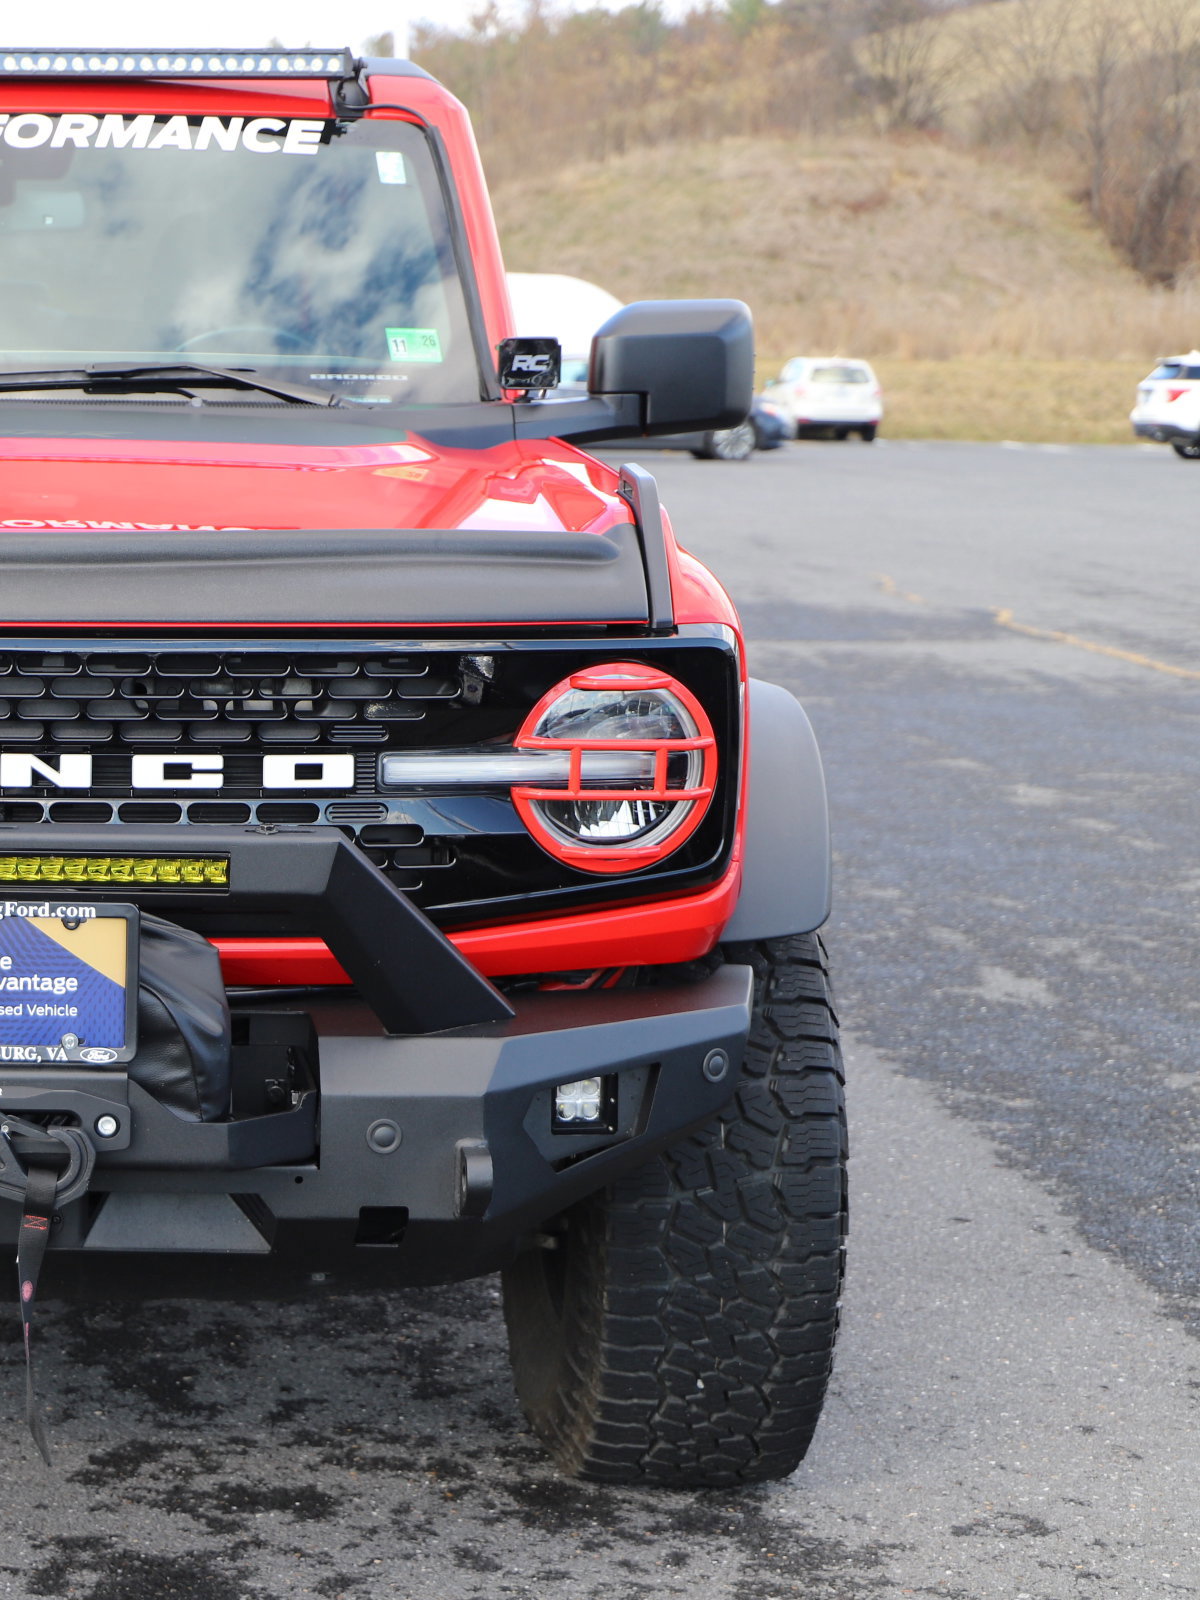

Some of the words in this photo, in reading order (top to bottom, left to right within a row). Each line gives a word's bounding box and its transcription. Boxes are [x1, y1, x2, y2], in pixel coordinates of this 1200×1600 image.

[392, 339, 407, 352] 11
[421, 335, 436, 347] 26
[510, 355, 551, 372] RC
[26, 1003, 78, 1017] Vehicle
[45, 1046, 68, 1061] VA
[88, 1049, 112, 1061] Ford
